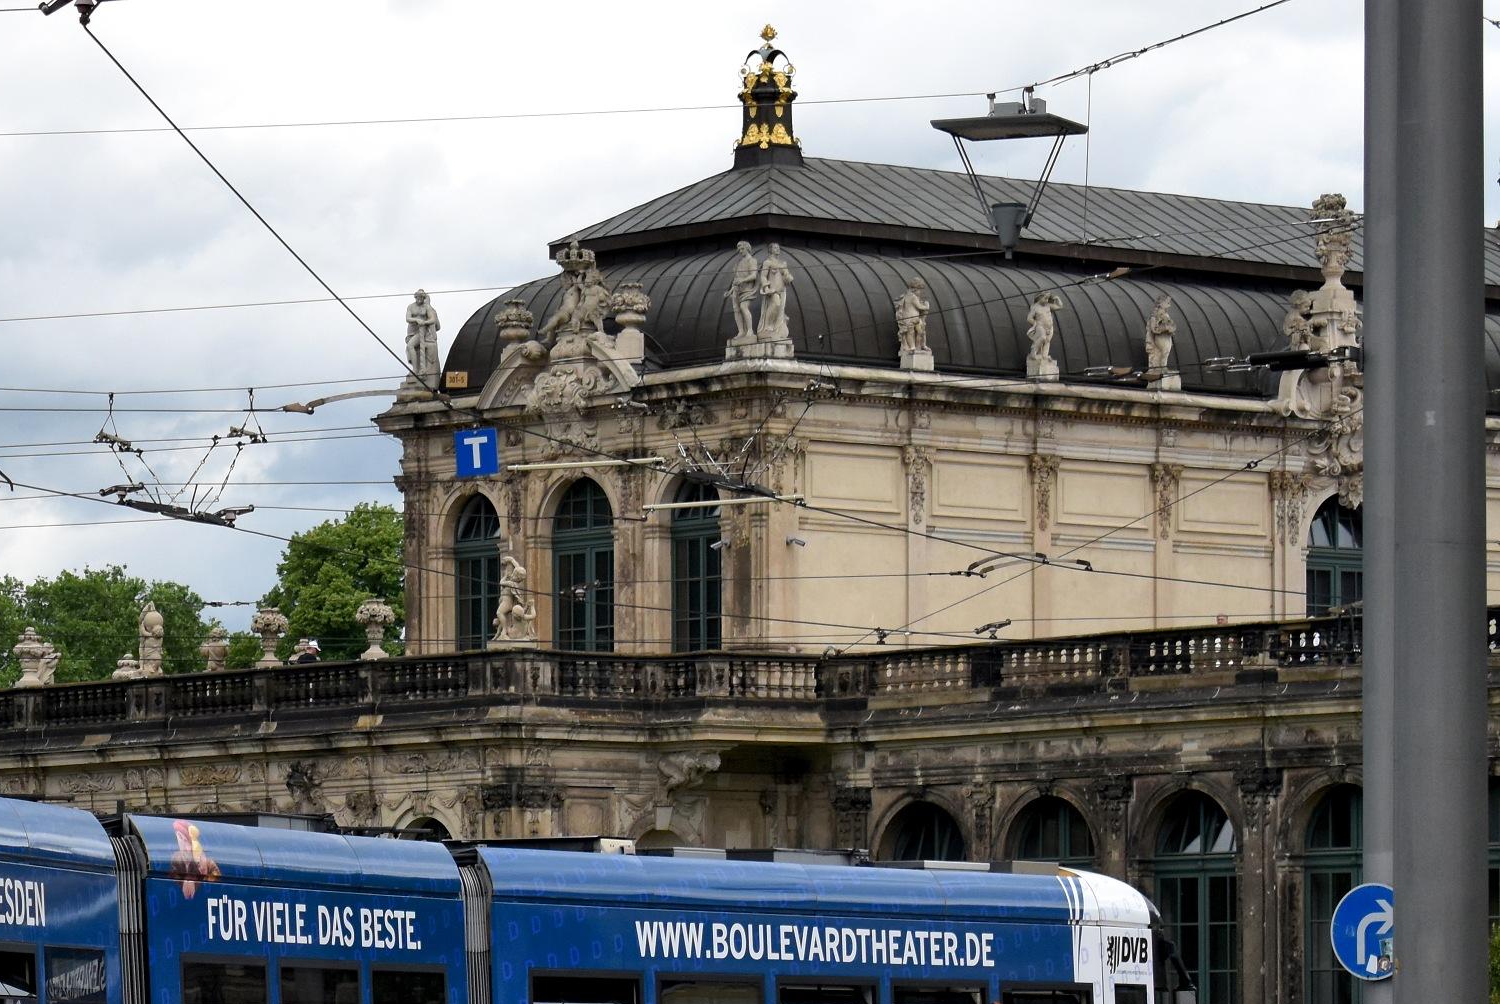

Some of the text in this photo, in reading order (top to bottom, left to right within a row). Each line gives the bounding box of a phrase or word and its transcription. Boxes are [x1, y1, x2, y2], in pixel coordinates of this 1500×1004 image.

[463, 436, 488, 469] T
[207, 894, 422, 950] FÜR VIELE. DAS BESTE.
[635, 920, 995, 967] WWW.BOULEVARDTHEATER.DE
[1121, 936, 1148, 964] DVB
